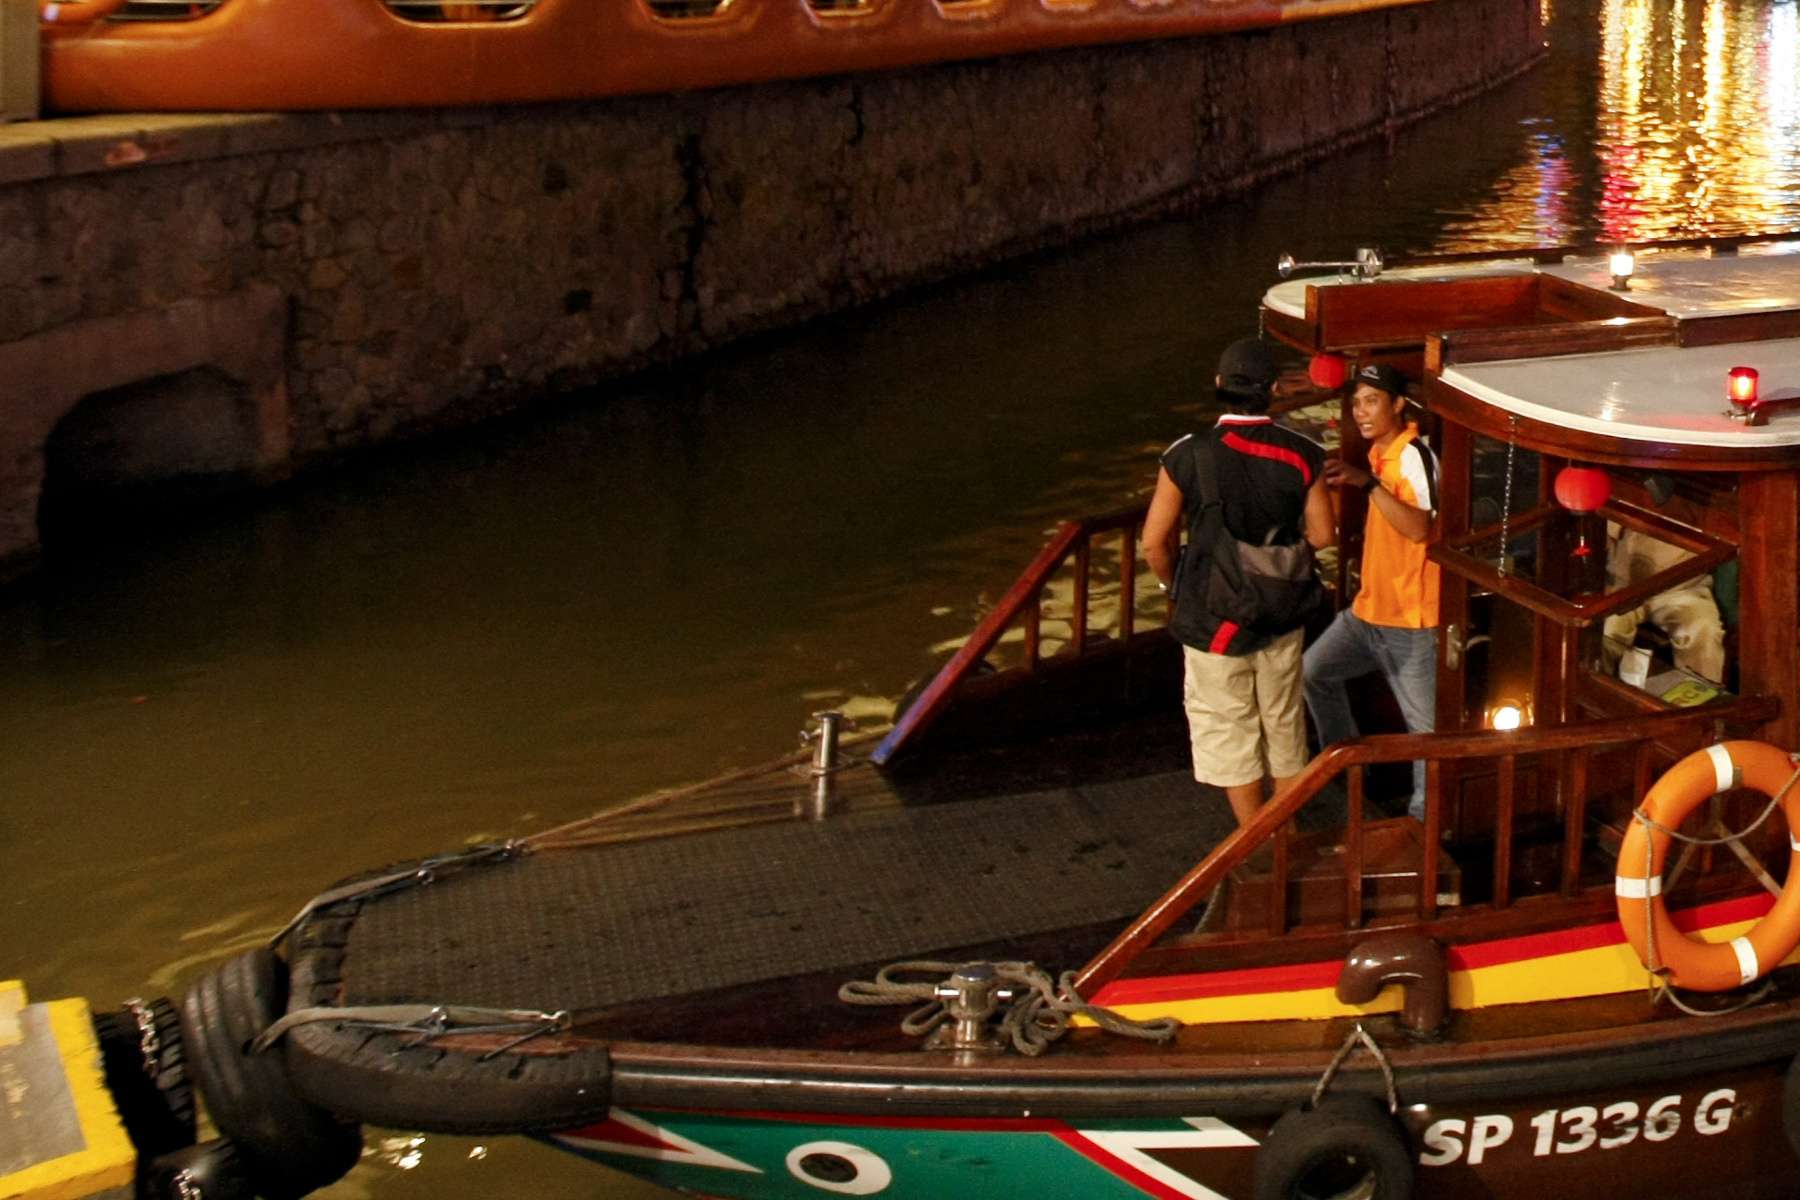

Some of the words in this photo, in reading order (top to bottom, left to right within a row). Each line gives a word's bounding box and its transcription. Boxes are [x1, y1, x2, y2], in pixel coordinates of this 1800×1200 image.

[1419, 1114, 1514, 1166] SP
[1530, 1095, 1682, 1156] 1336
[1693, 1088, 1737, 1135] G
